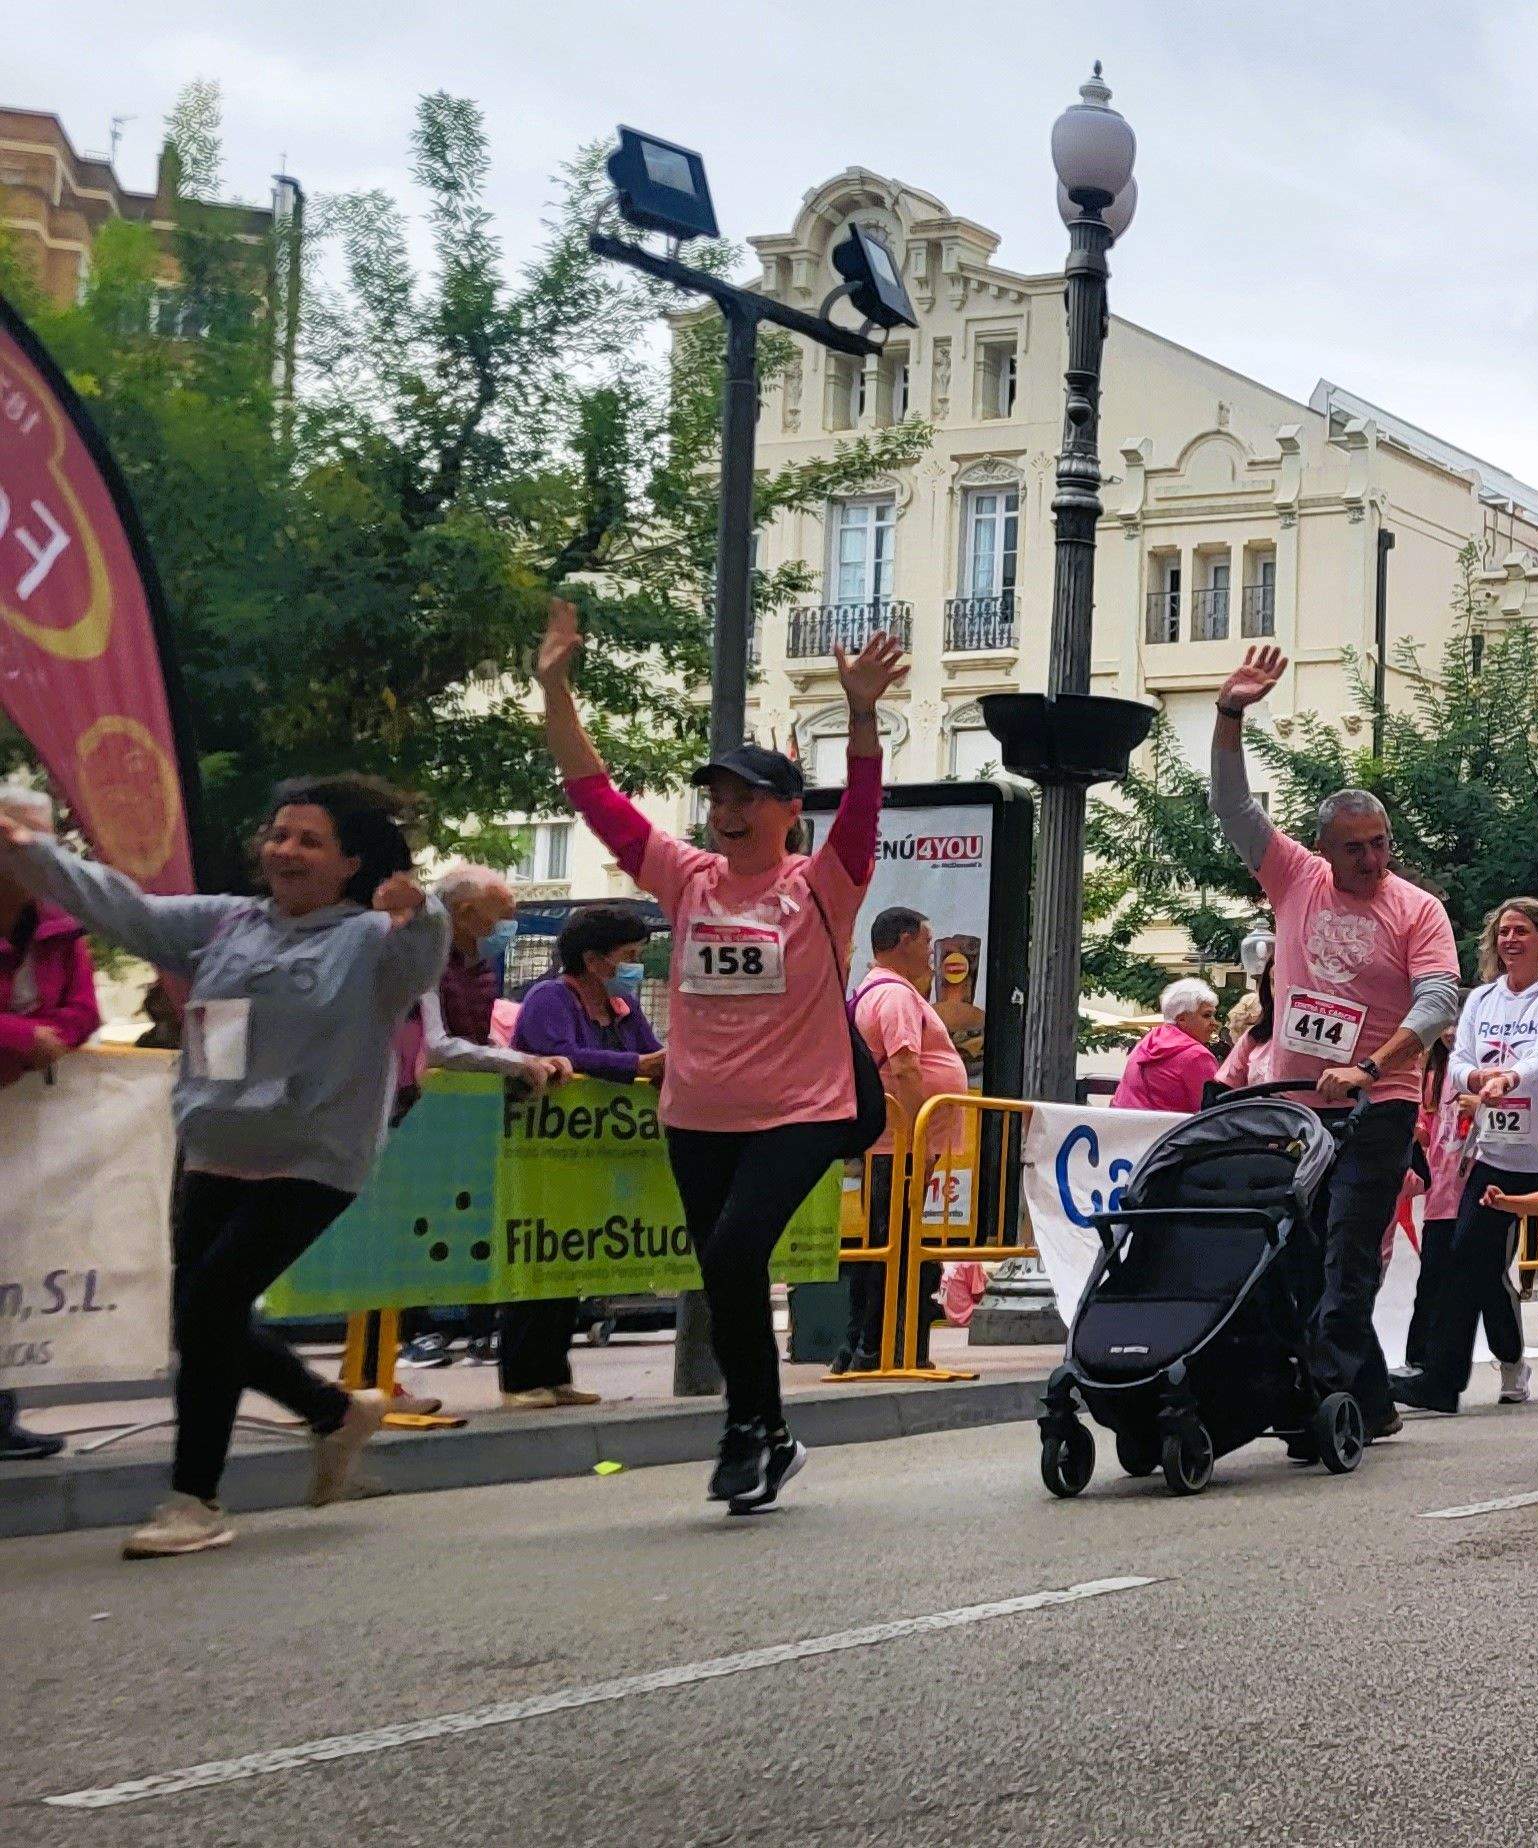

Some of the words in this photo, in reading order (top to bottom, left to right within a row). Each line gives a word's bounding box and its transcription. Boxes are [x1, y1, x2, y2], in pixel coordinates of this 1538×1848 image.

[699, 946, 763, 975] 158
[1294, 1013, 1343, 1045] 414
[1488, 1110, 1520, 1131] 192
